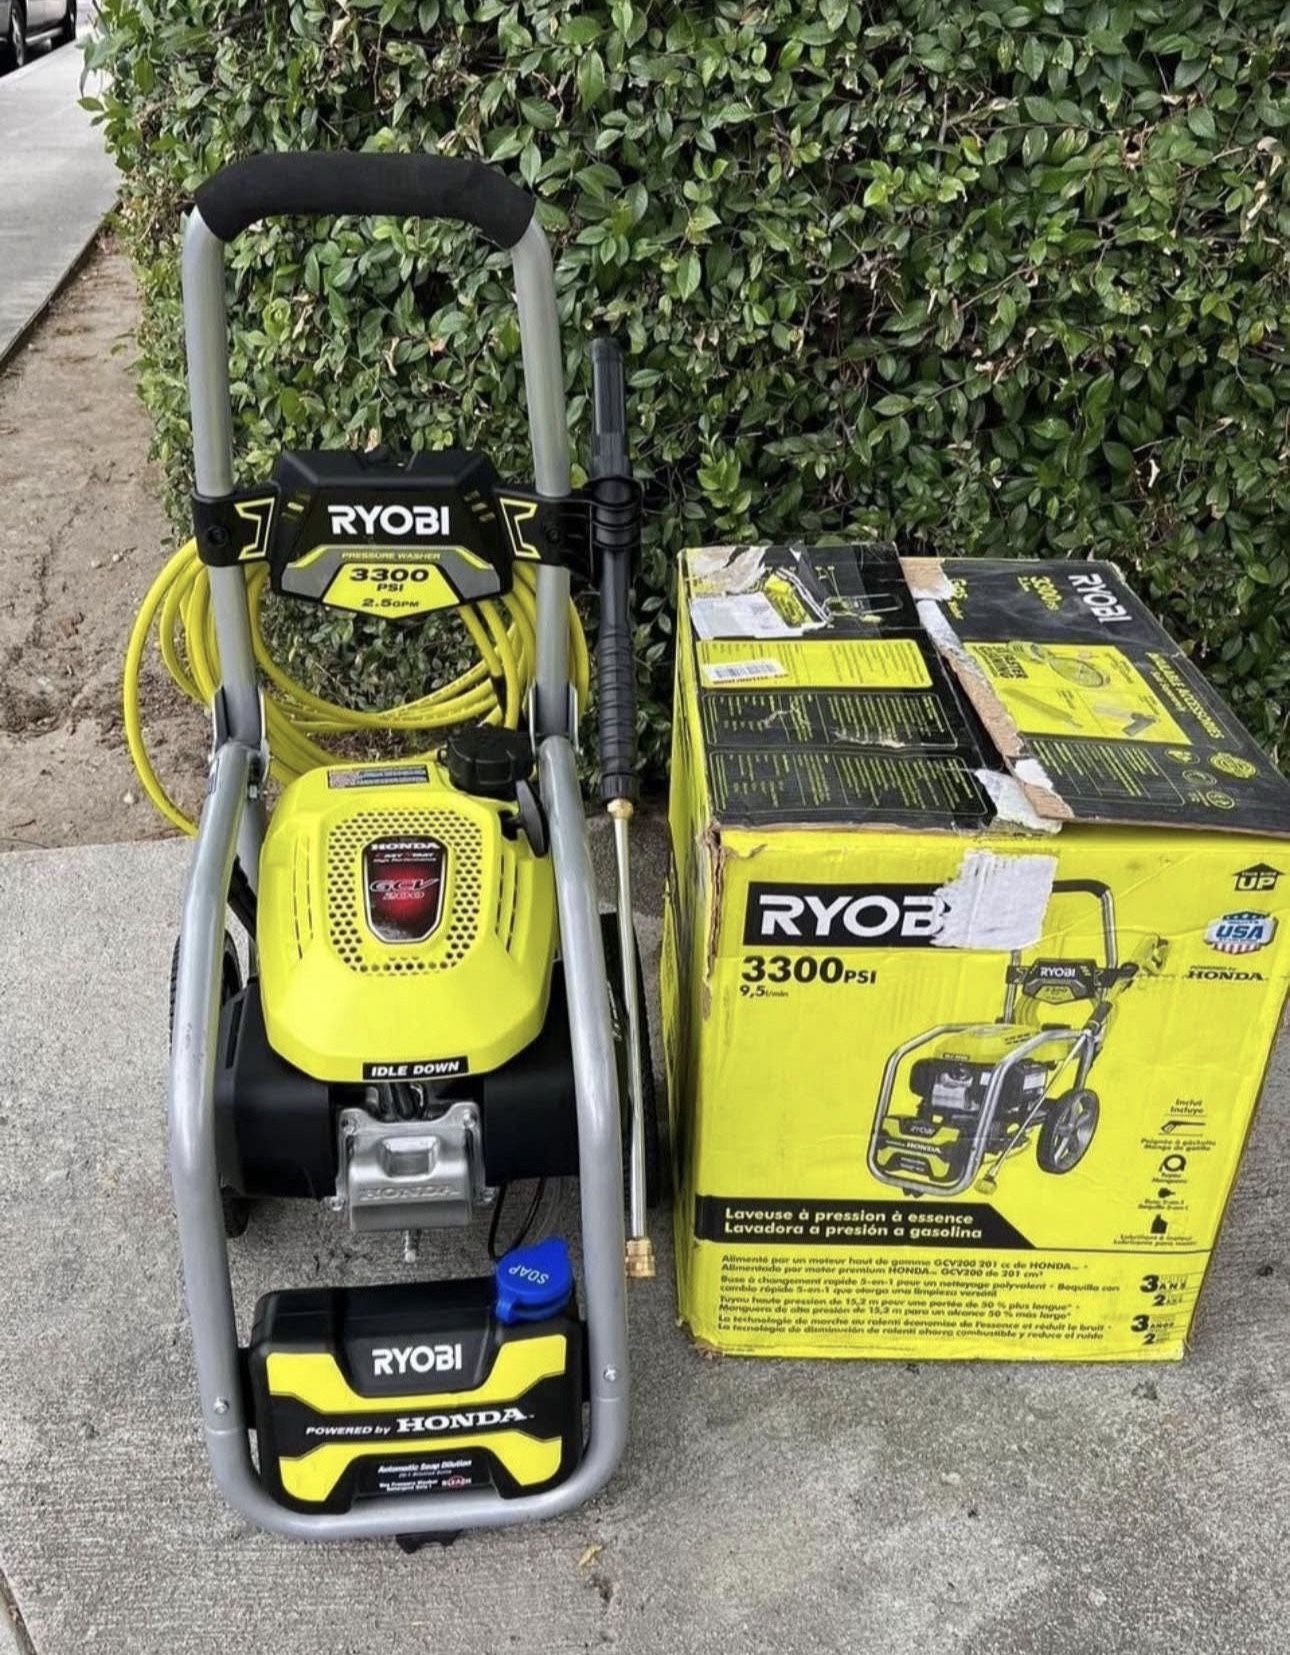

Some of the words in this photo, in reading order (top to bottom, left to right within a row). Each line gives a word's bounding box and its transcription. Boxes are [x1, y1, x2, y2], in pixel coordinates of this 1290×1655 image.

[328, 505, 449, 535] RYOBI
[341, 552, 395, 560] PRESSURE
[398, 552, 440, 560] WASHER
[350, 568, 429, 582] 3300
[377, 583, 403, 592] PSI
[1068, 573, 1132, 623] RYOBI
[1175, 688, 1225, 739] ACCESSORIES
[370, 842, 441, 851] HONDA
[1238, 876, 1275, 890] UP
[760, 895, 944, 937] RYOB
[1216, 925, 1264, 940] USA
[1040, 966, 1076, 978] RYOBI
[1187, 971, 1264, 981] HONDA
[371, 1065, 408, 1078] IDLE
[413, 1060, 459, 1074] DOWN
[360, 1186, 461, 1202] HONDA
[725, 1208, 794, 1220] Laveuse
[798, 1208, 810, 1220] à
[815, 1209, 886, 1223] pression
[892, 1210, 902, 1222] à
[908, 1213, 974, 1224] essence
[724, 1222, 804, 1234] Lavadora
[809, 1224, 820, 1235] a
[826, 1223, 888, 1238] presión
[894, 1226, 904, 1236] a
[910, 1225, 982, 1239] gasolina
[887, 1266, 932, 1274] HONDA
[1028, 1261, 1073, 1270] HONDA
[508, 1264, 549, 1284] SOAP
[1140, 1274, 1160, 1292] 3
[1152, 1294, 1166, 1306] 2
[1130, 1314, 1150, 1332] 3
[1142, 1333, 1156, 1344] 2
[372, 1344, 462, 1376] RYOBI
[306, 1426, 373, 1436] POWERED
[374, 1426, 391, 1436] by
[396, 1407, 527, 1432] HONDA
[378, 1463, 419, 1473] Automatic
[420, 1462, 440, 1472] Soap
[441, 1459, 472, 1468] Dilution
